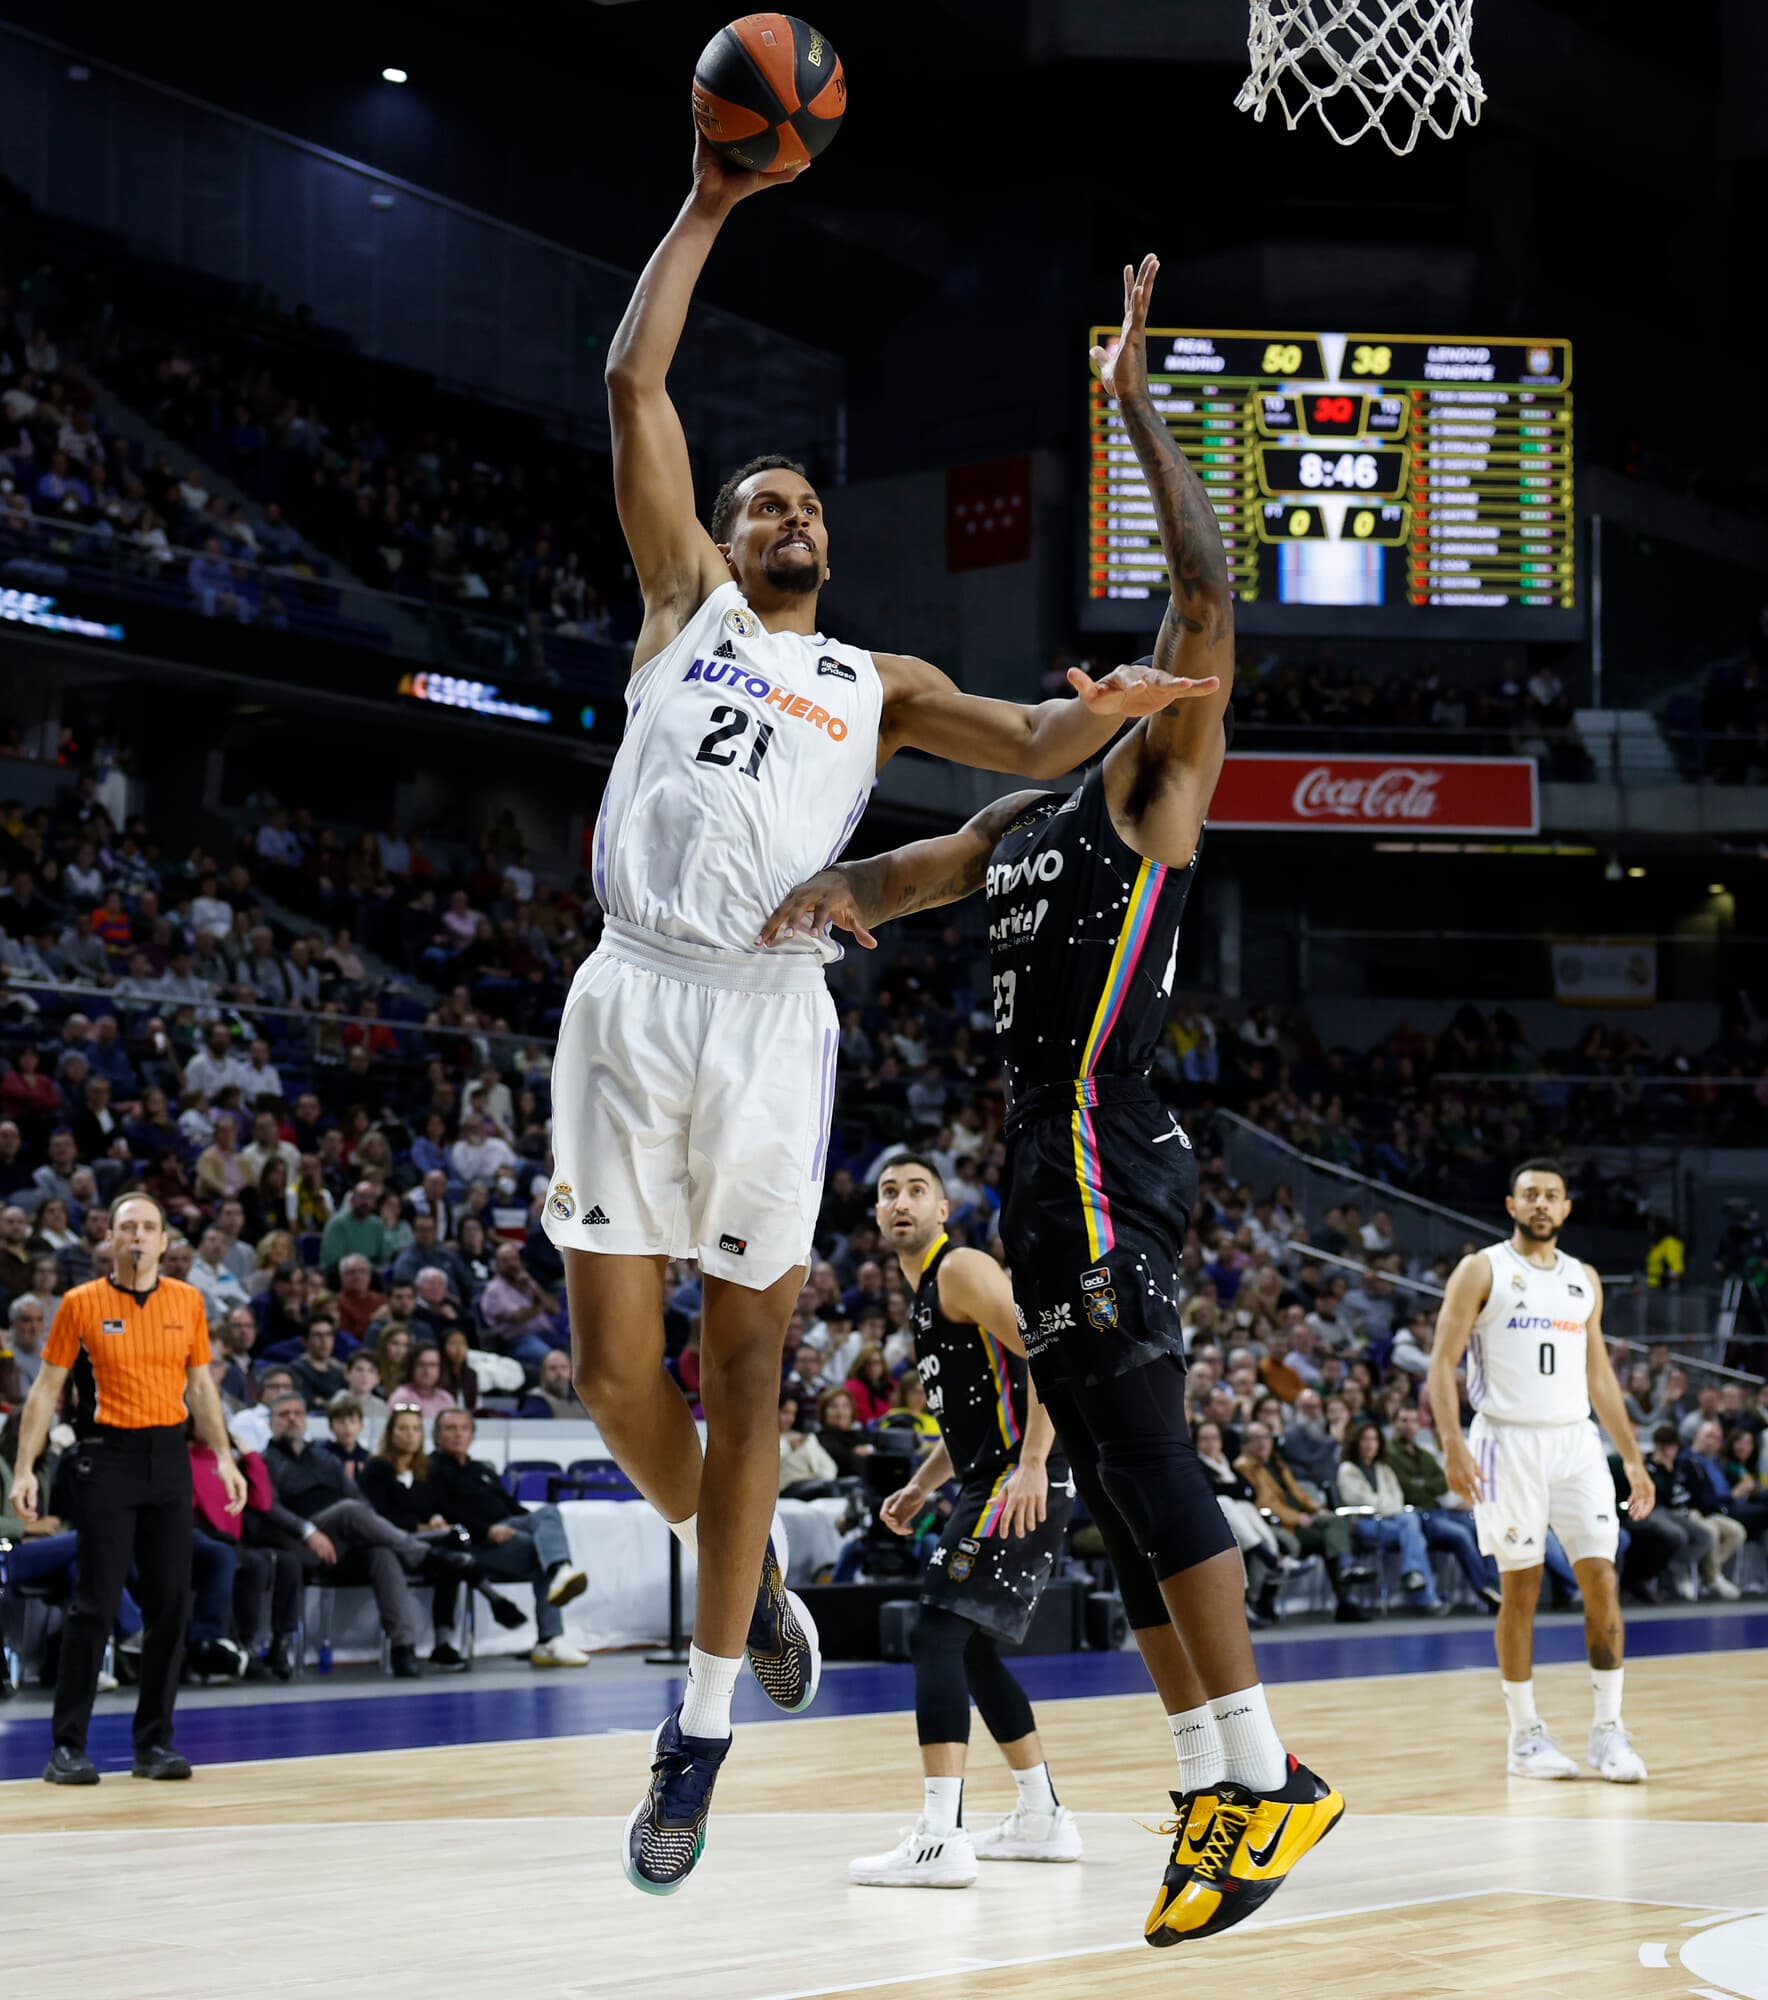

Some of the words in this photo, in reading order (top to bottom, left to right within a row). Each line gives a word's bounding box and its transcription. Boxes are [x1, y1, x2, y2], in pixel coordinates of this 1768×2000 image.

[1262, 344, 1303, 374] 50
[1352, 345, 1392, 375] 38
[1299, 453, 1378, 489] 8:46
[1289, 509, 1311, 536] 0
[1353, 511, 1375, 538] 0
[682, 659, 848, 742] AUTOHERO
[695, 705, 774, 782] 21
[1293, 767, 1445, 818] Coca-Cola
[986, 849, 1064, 901] enovo
[581, 1217, 610, 1225] adidas
[720, 1240, 740, 1253] acb
[1083, 1276, 1105, 1288] acb
[1539, 1342, 1555, 1376] 0
